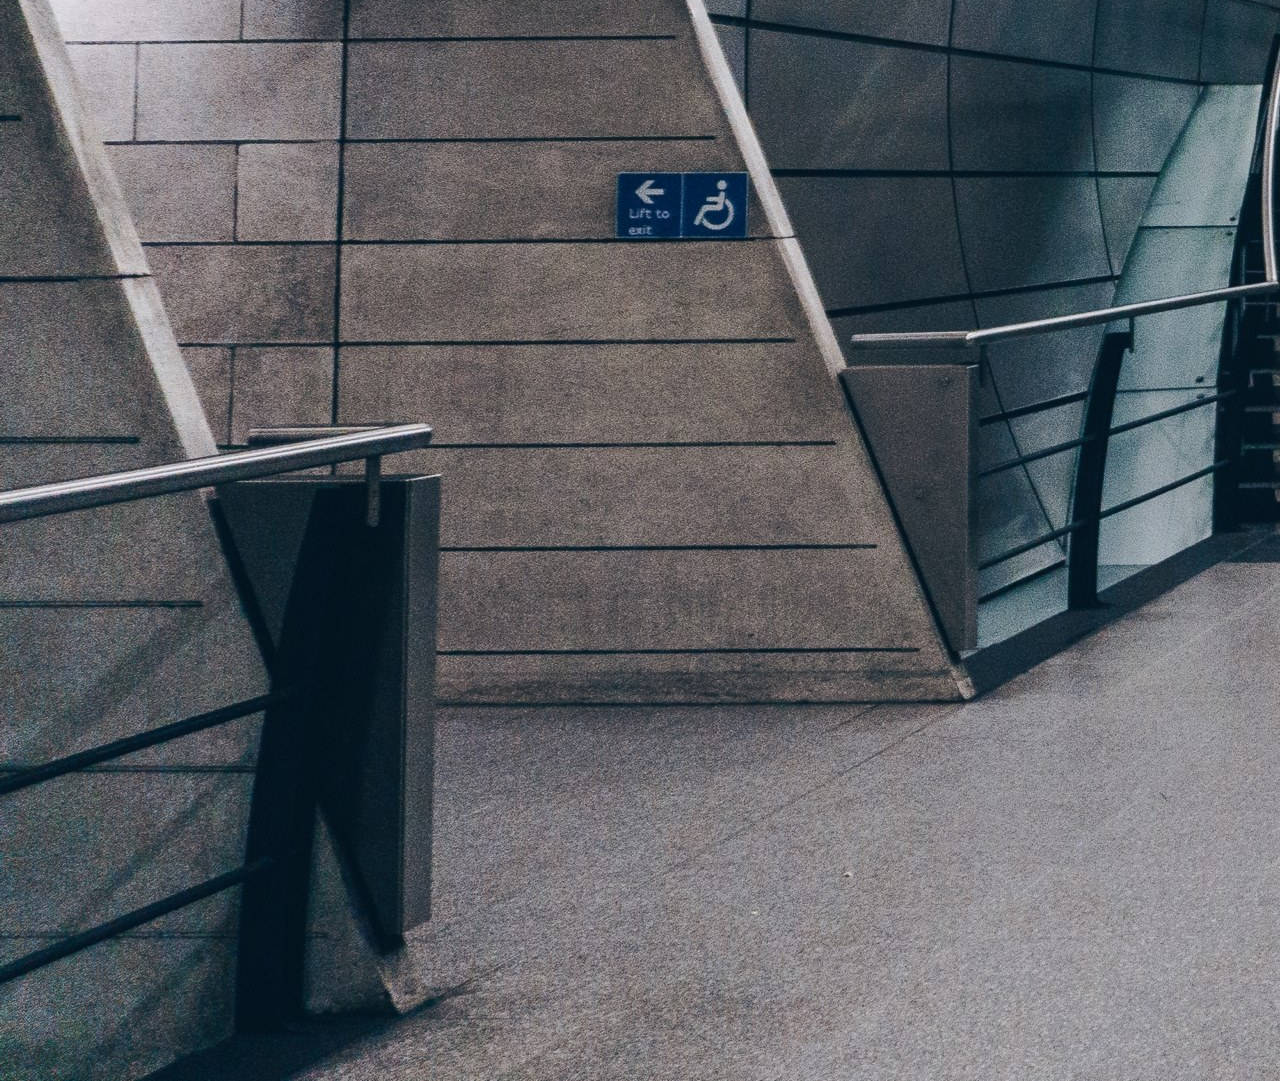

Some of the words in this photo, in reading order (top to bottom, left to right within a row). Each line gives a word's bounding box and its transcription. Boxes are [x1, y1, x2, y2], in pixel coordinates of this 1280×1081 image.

[628, 208, 652, 219] Lift
[655, 209, 670, 219] to
[628, 225, 653, 236] exit
